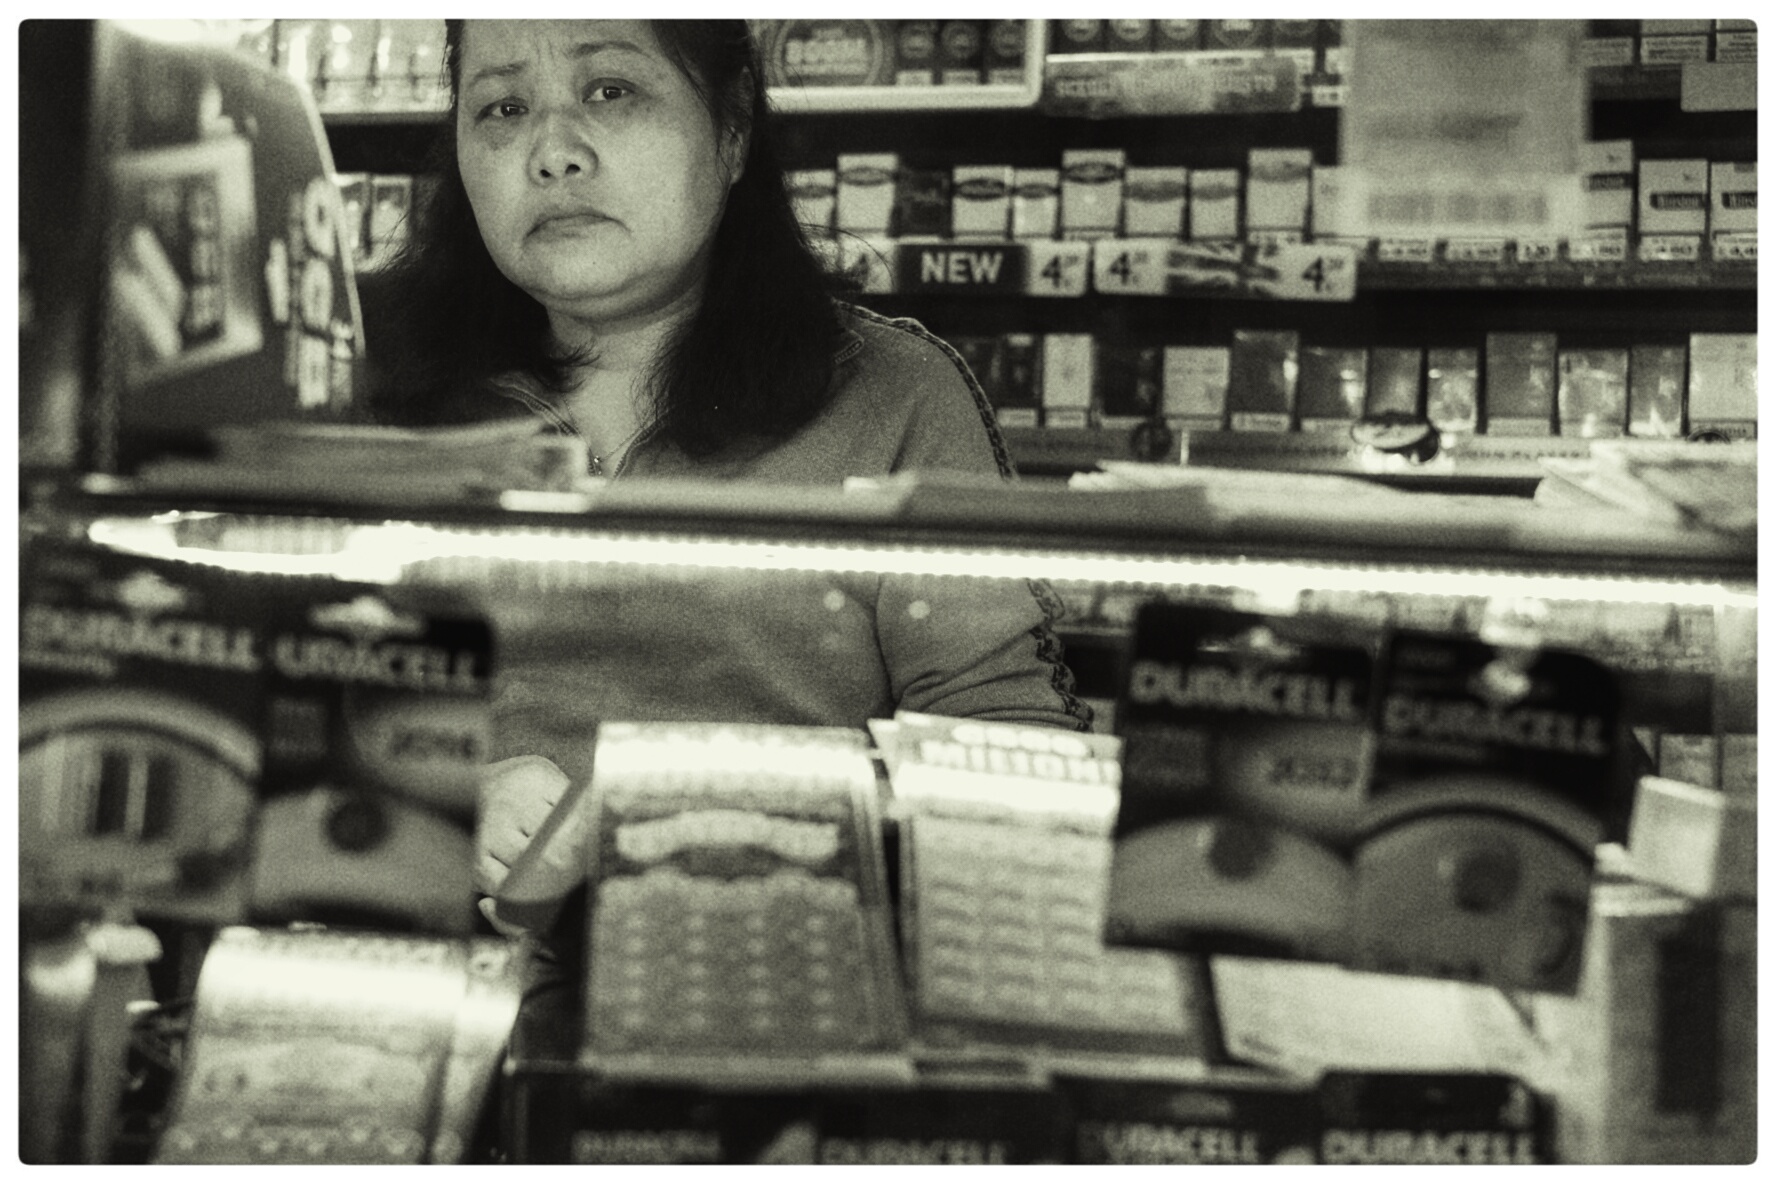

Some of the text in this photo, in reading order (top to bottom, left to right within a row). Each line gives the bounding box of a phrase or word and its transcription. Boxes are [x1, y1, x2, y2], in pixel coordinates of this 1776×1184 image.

[921, 251, 1002, 283] NEW
[1131, 660, 1357, 720] DURACELL
[1383, 695, 1610, 755] DURACELL
